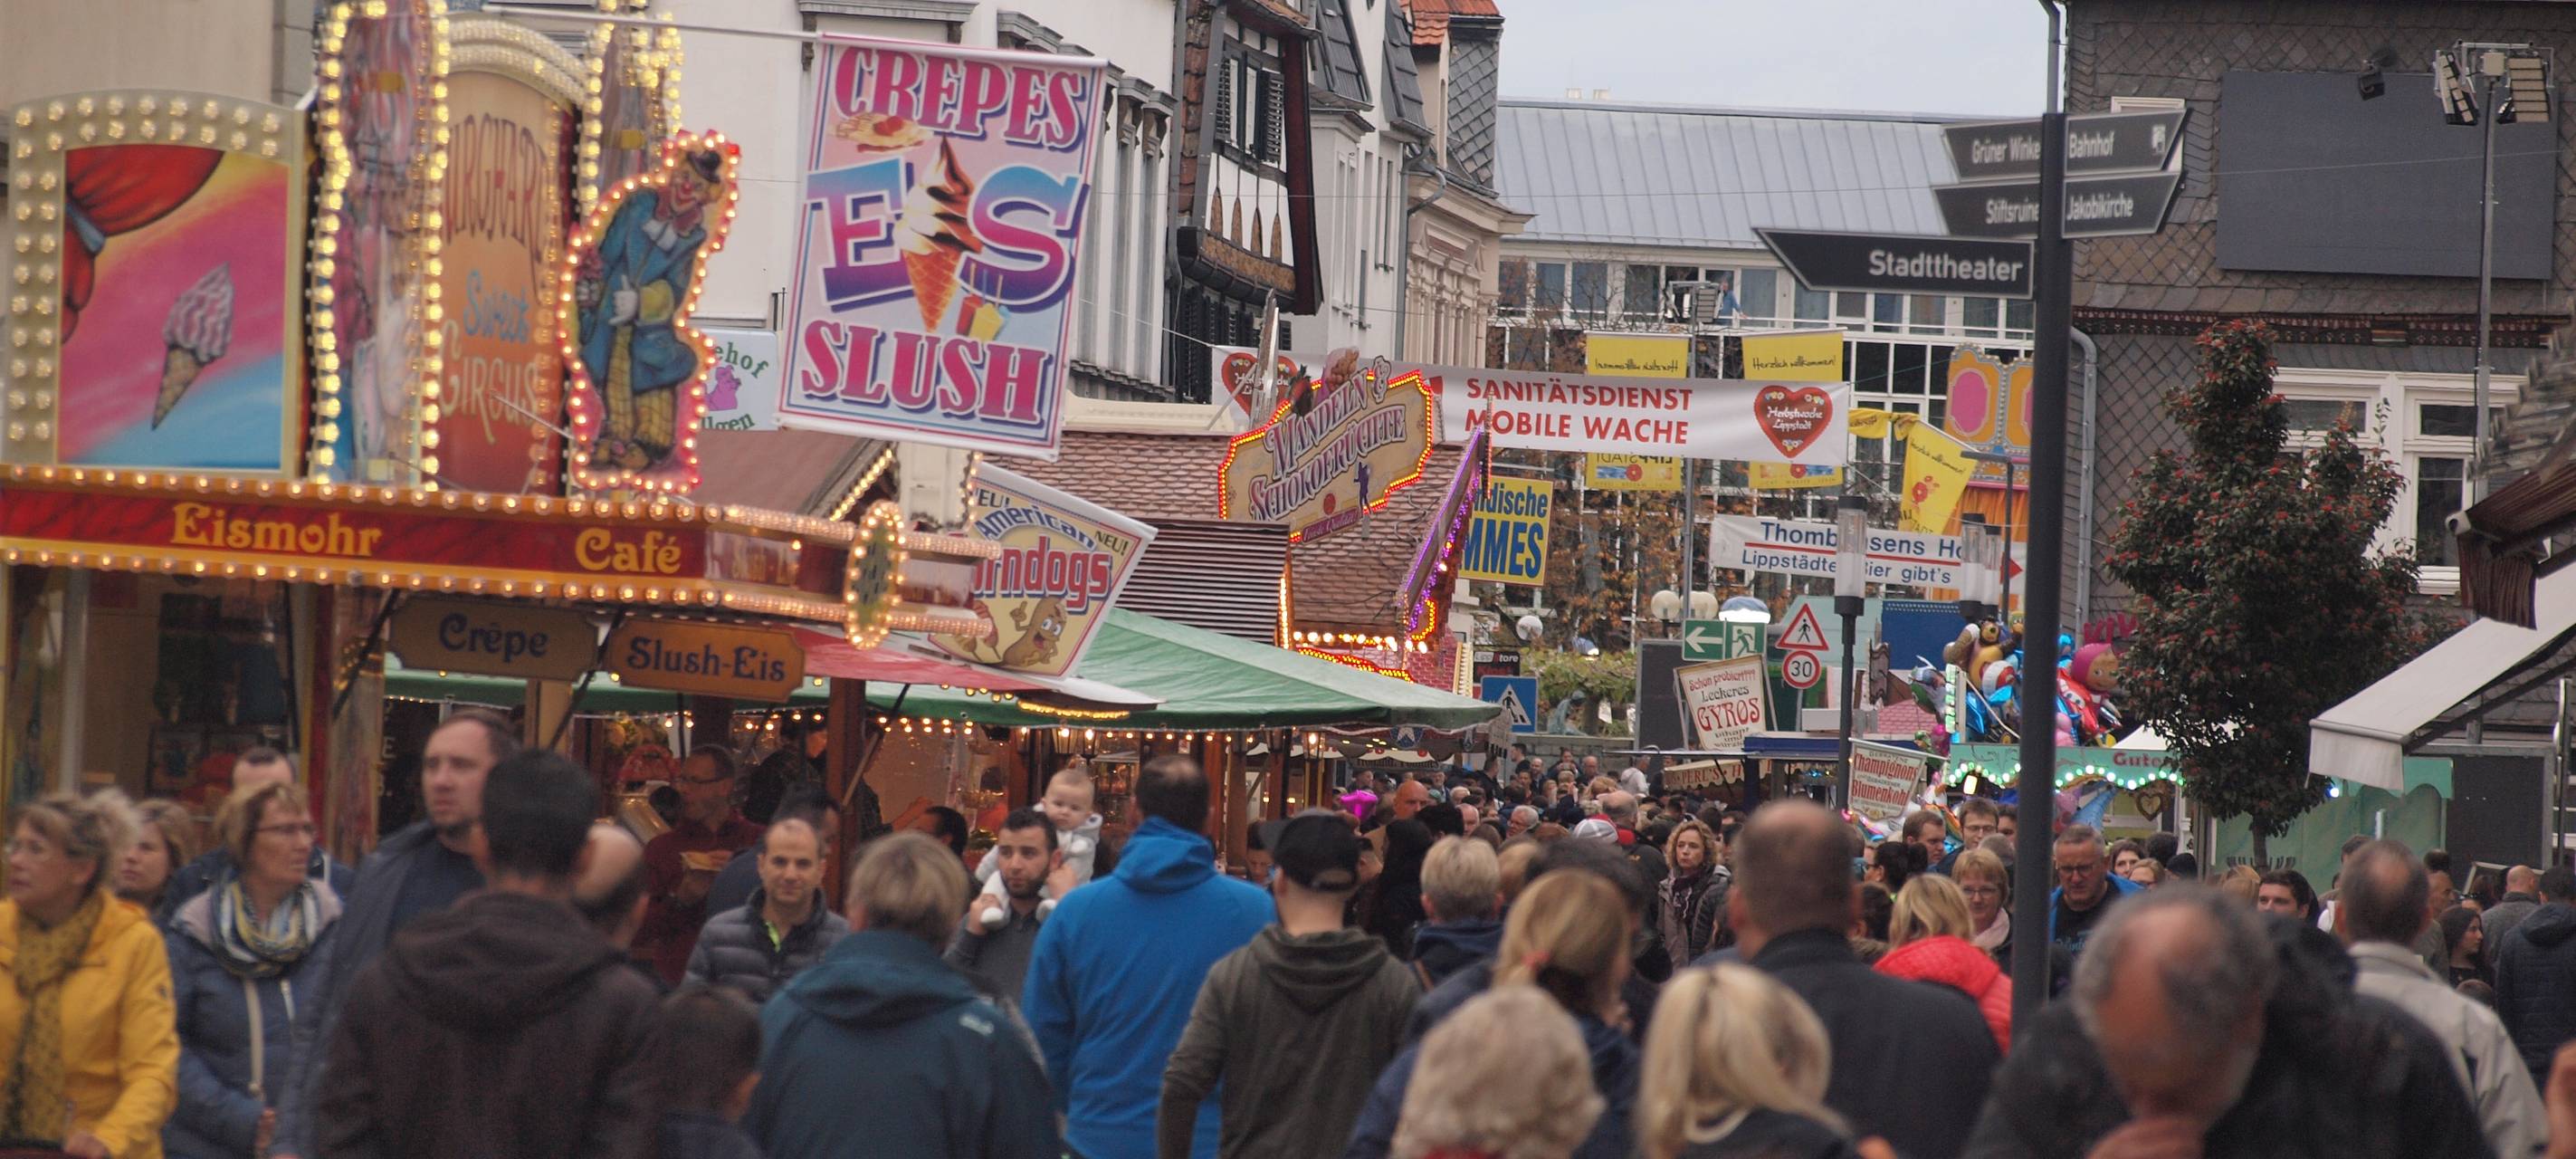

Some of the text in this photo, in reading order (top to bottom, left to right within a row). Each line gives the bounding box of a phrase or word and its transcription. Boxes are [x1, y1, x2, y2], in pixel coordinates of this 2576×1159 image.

[835, 46, 1086, 150] CREPES
[1971, 135, 2041, 164] Grüner Winke
[2068, 131, 2115, 158] Bahnhof
[1985, 196, 2040, 225] Stiftsruine
[2066, 192, 2134, 221] Jakobikirche
[1868, 248, 2025, 283] Stadttheater
[801, 319, 1050, 427] SLUSH
[1752, 357, 1789, 370] Herzlich
[1466, 377, 1693, 411] SANITÄTSDIENST
[1464, 408, 1689, 445] MOBILE WACHE
[1772, 418, 1812, 432] Lippstadt
[172, 502, 382, 558] Eismohr
[574, 527, 682, 575] Café
[975, 503, 1097, 551] American
[1094, 529, 1130, 557] NEU!
[1760, 521, 1925, 556] Thombsens
[1741, 549, 1837, 573] Lippstädte
[1901, 565, 1951, 585] gibt's
[438, 614, 549, 662] Crêpe
[625, 636, 787, 685] Slush-Eis
[1790, 660, 1813, 677] 30
[1702, 685, 1751, 703] Leckeres
[1853, 752, 1919, 782] Champignons
[1852, 780, 1911, 806] Blumenkohl
